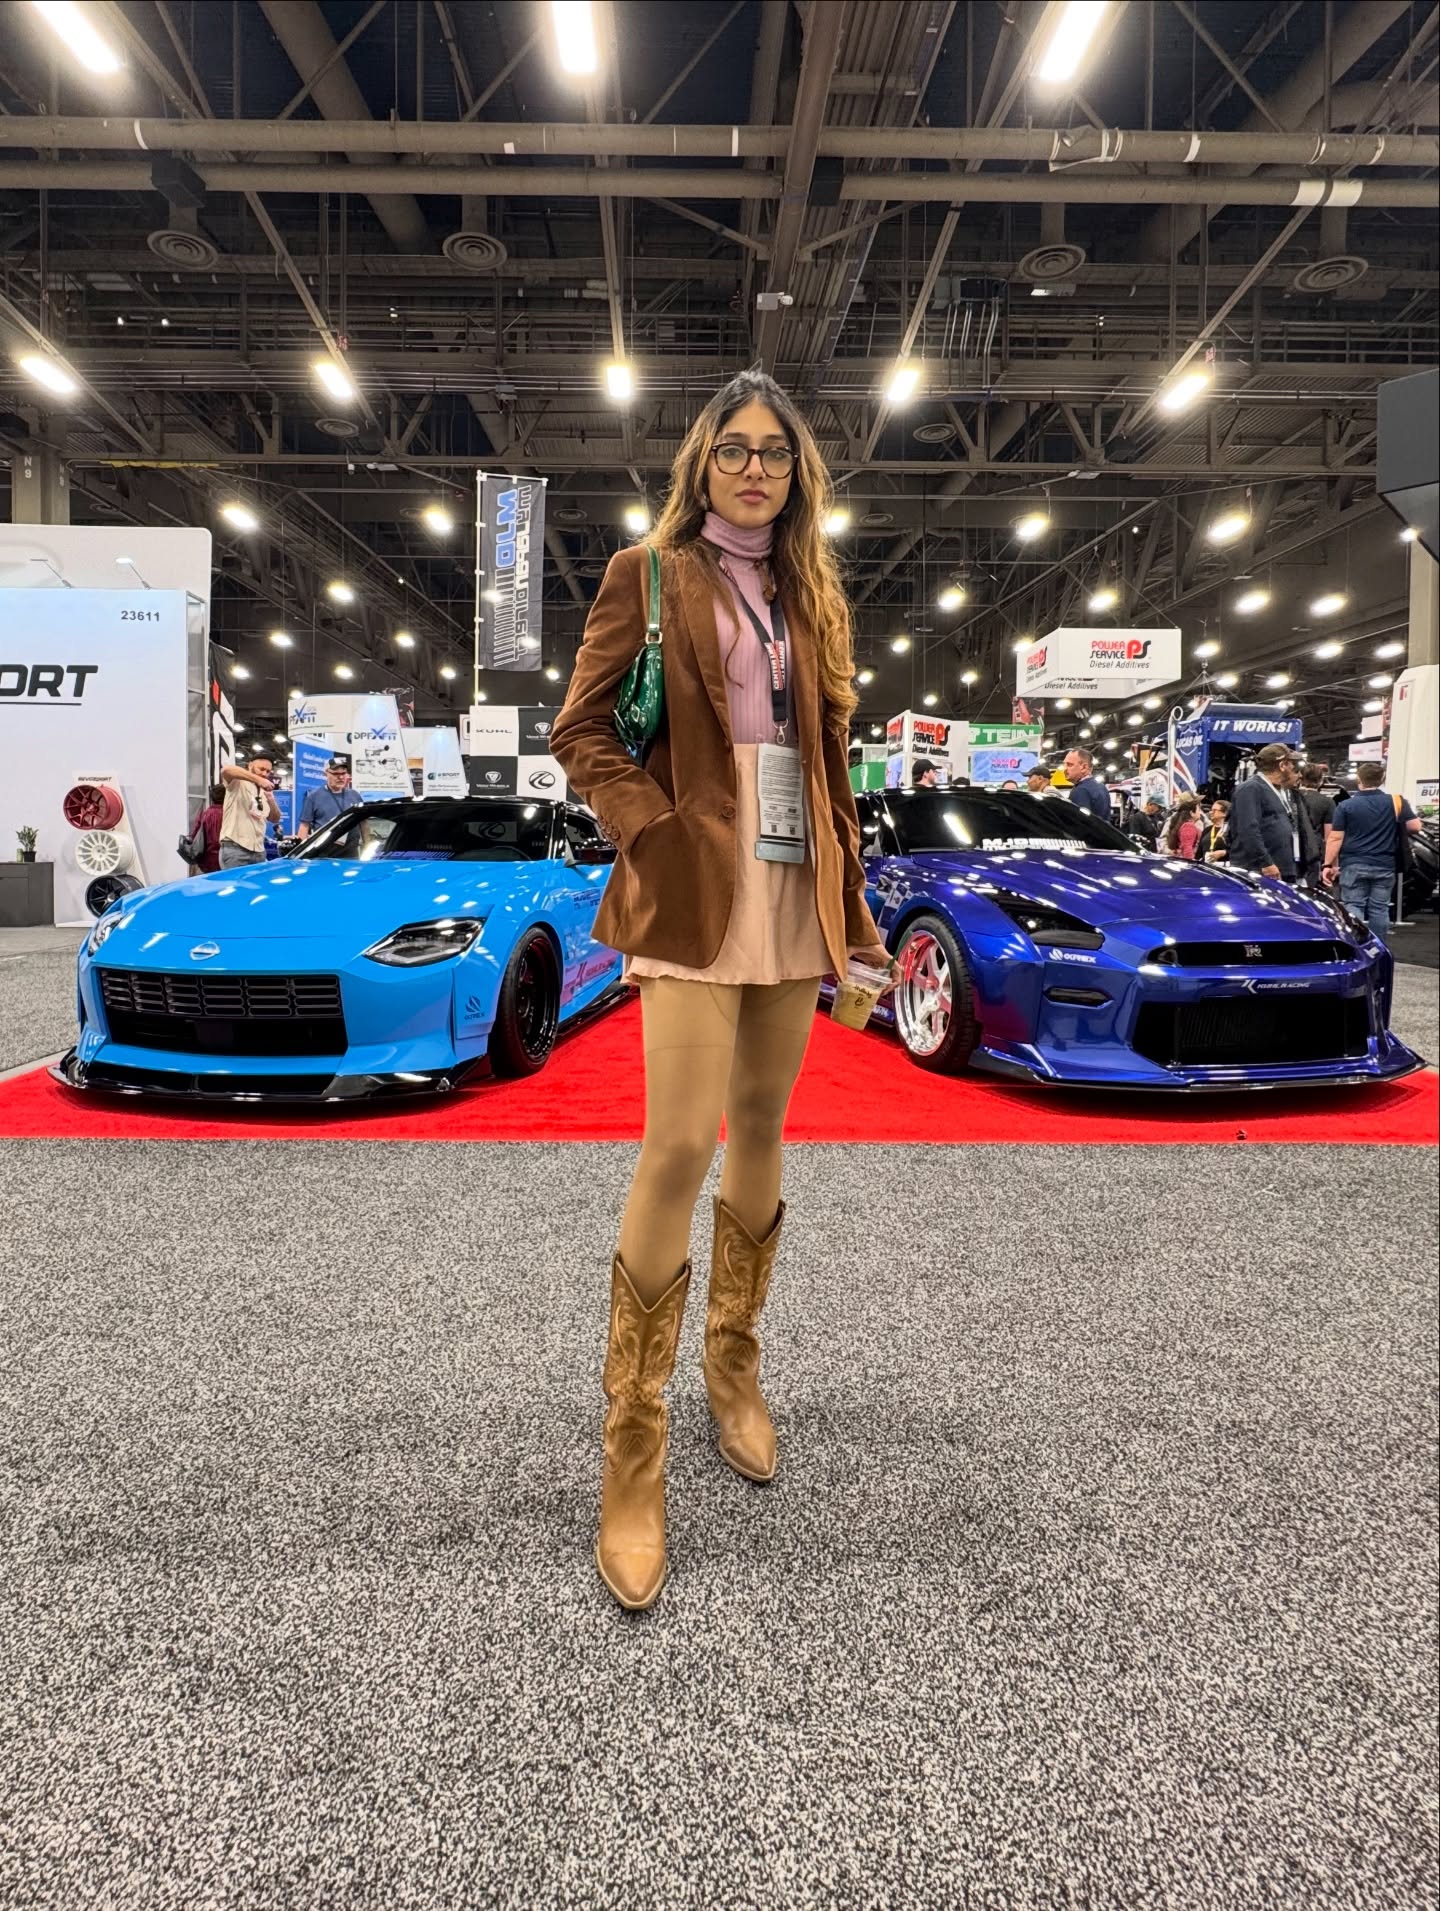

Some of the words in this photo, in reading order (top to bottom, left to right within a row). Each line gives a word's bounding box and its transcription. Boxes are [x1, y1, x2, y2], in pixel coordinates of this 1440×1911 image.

[24, 469, 32, 479] 9
[120, 610, 160, 622] 23611
[1091, 641, 1126, 650] POWER
[1089, 650, 1126, 659] SERVICE
[1089, 660, 1113, 669] Diesel
[1115, 660, 1150, 669] Additives
[1044, 682, 1065, 690] Diesel
[1068, 682, 1098, 690] Additives
[913, 720, 935, 734] POWER
[1213, 719, 1229, 731] IT
[1233, 720, 1292, 733] WORKS!
[912, 732, 935, 745] SERVICE
[983, 728, 1035, 742] TEIN
[1176, 736, 1193, 748] LUCAS
